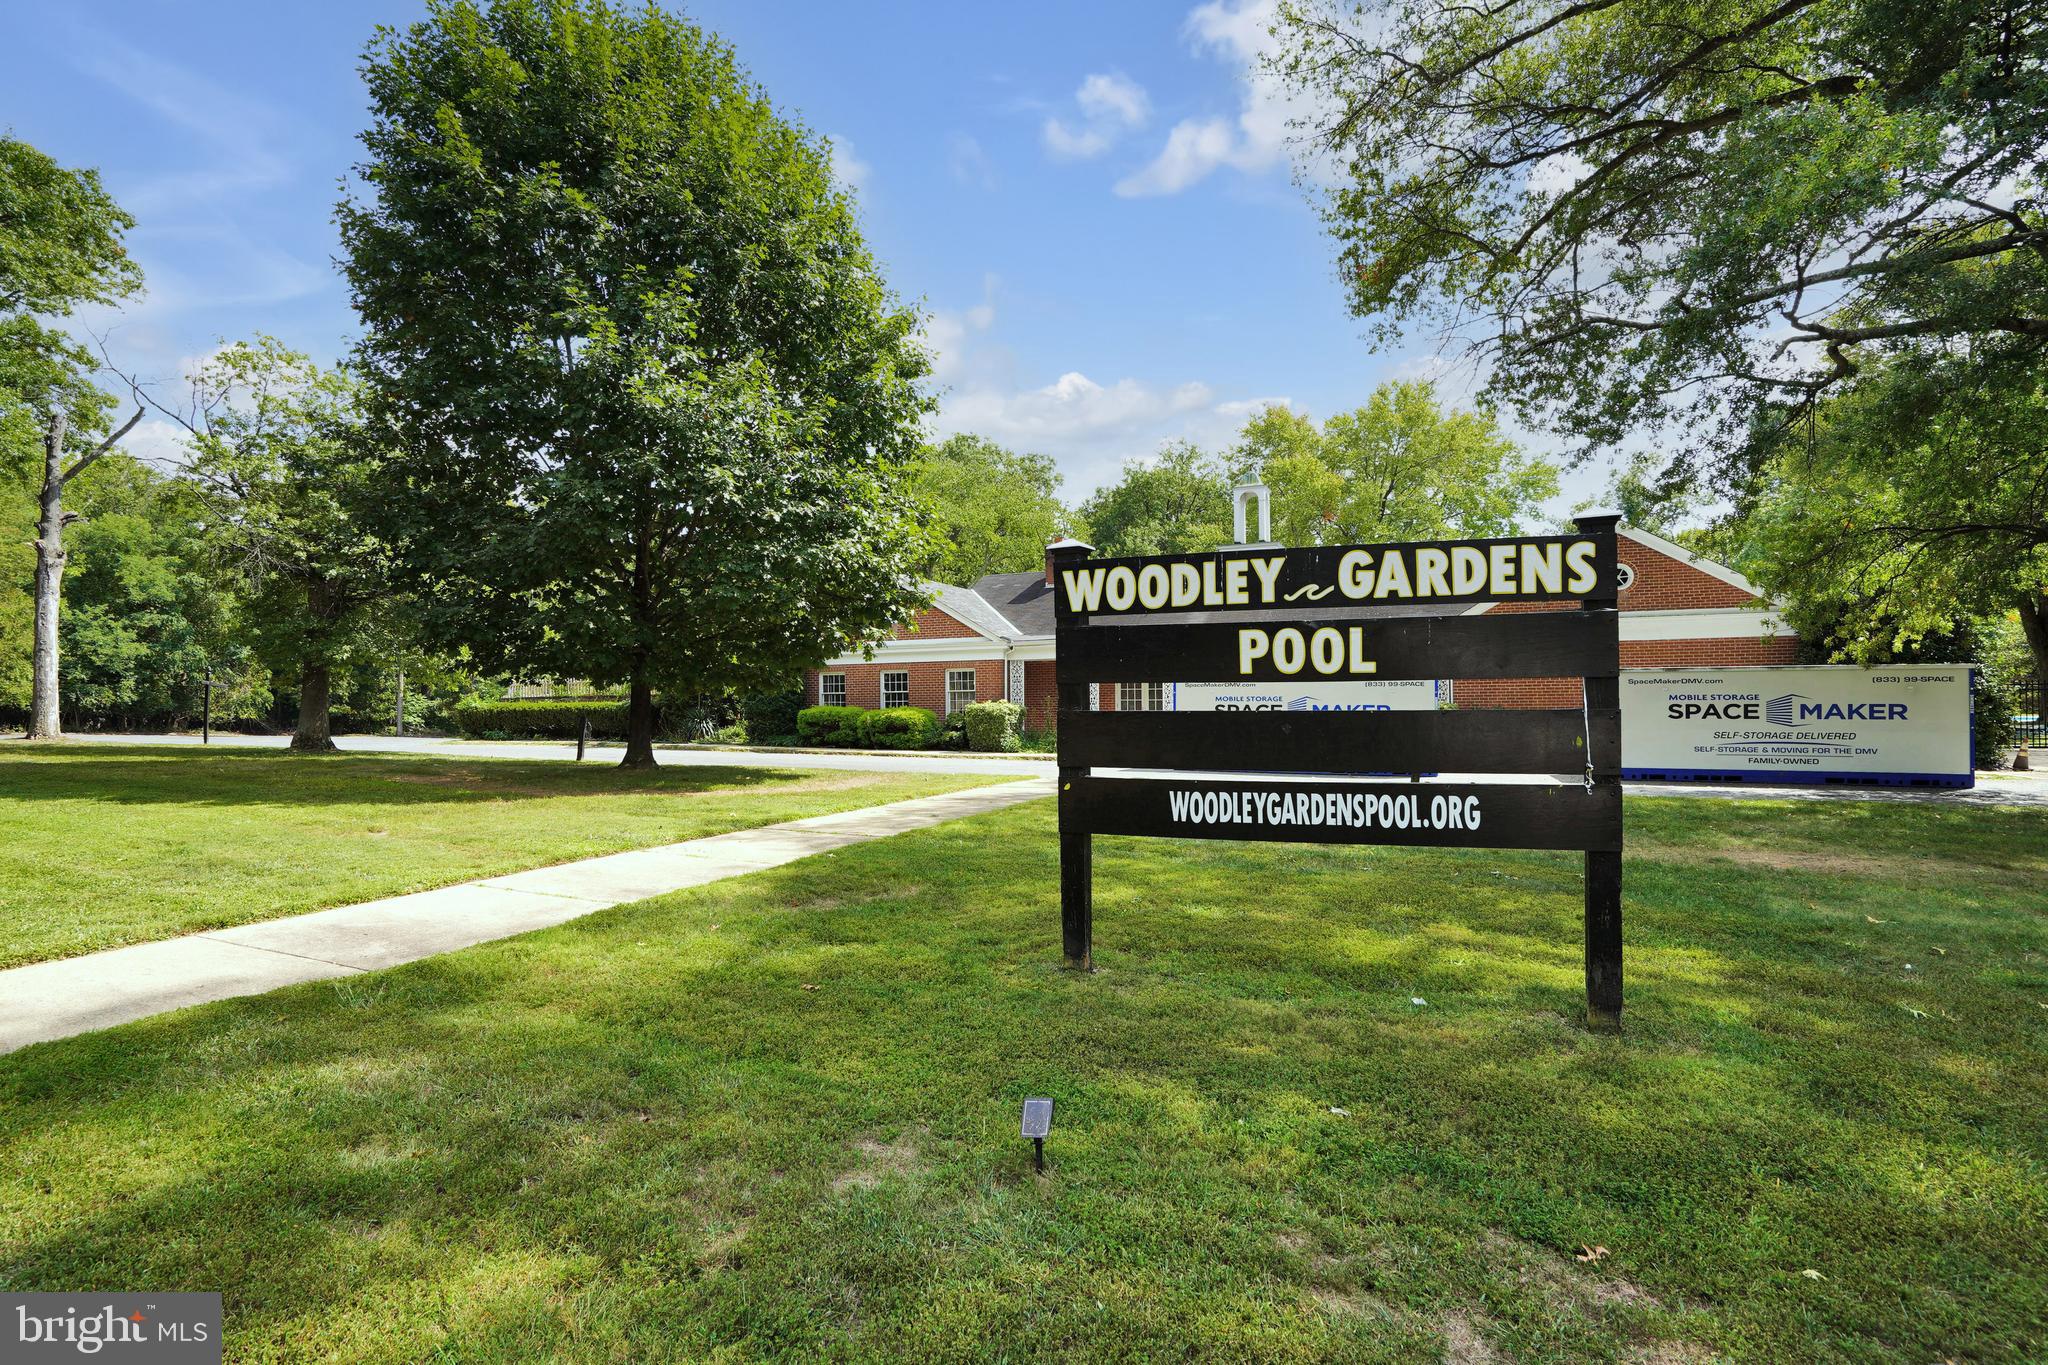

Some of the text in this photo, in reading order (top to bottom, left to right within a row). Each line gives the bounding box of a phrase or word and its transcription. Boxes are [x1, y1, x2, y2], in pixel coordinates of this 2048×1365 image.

[1062, 540, 1598, 613] WOODLEY GARDENS
[1238, 626, 1377, 675] POOL
[1668, 703, 1908, 720] SPACE MAKER
[1713, 731, 1857, 741] SELF-STORAGE DELIVERED
[1694, 746, 1759, 754] SELF-STORAGE
[1748, 757, 1820, 765] FAMILY-OWNED
[1169, 790, 1481, 831] WOODLEYGARDENSPOOL.ORG
